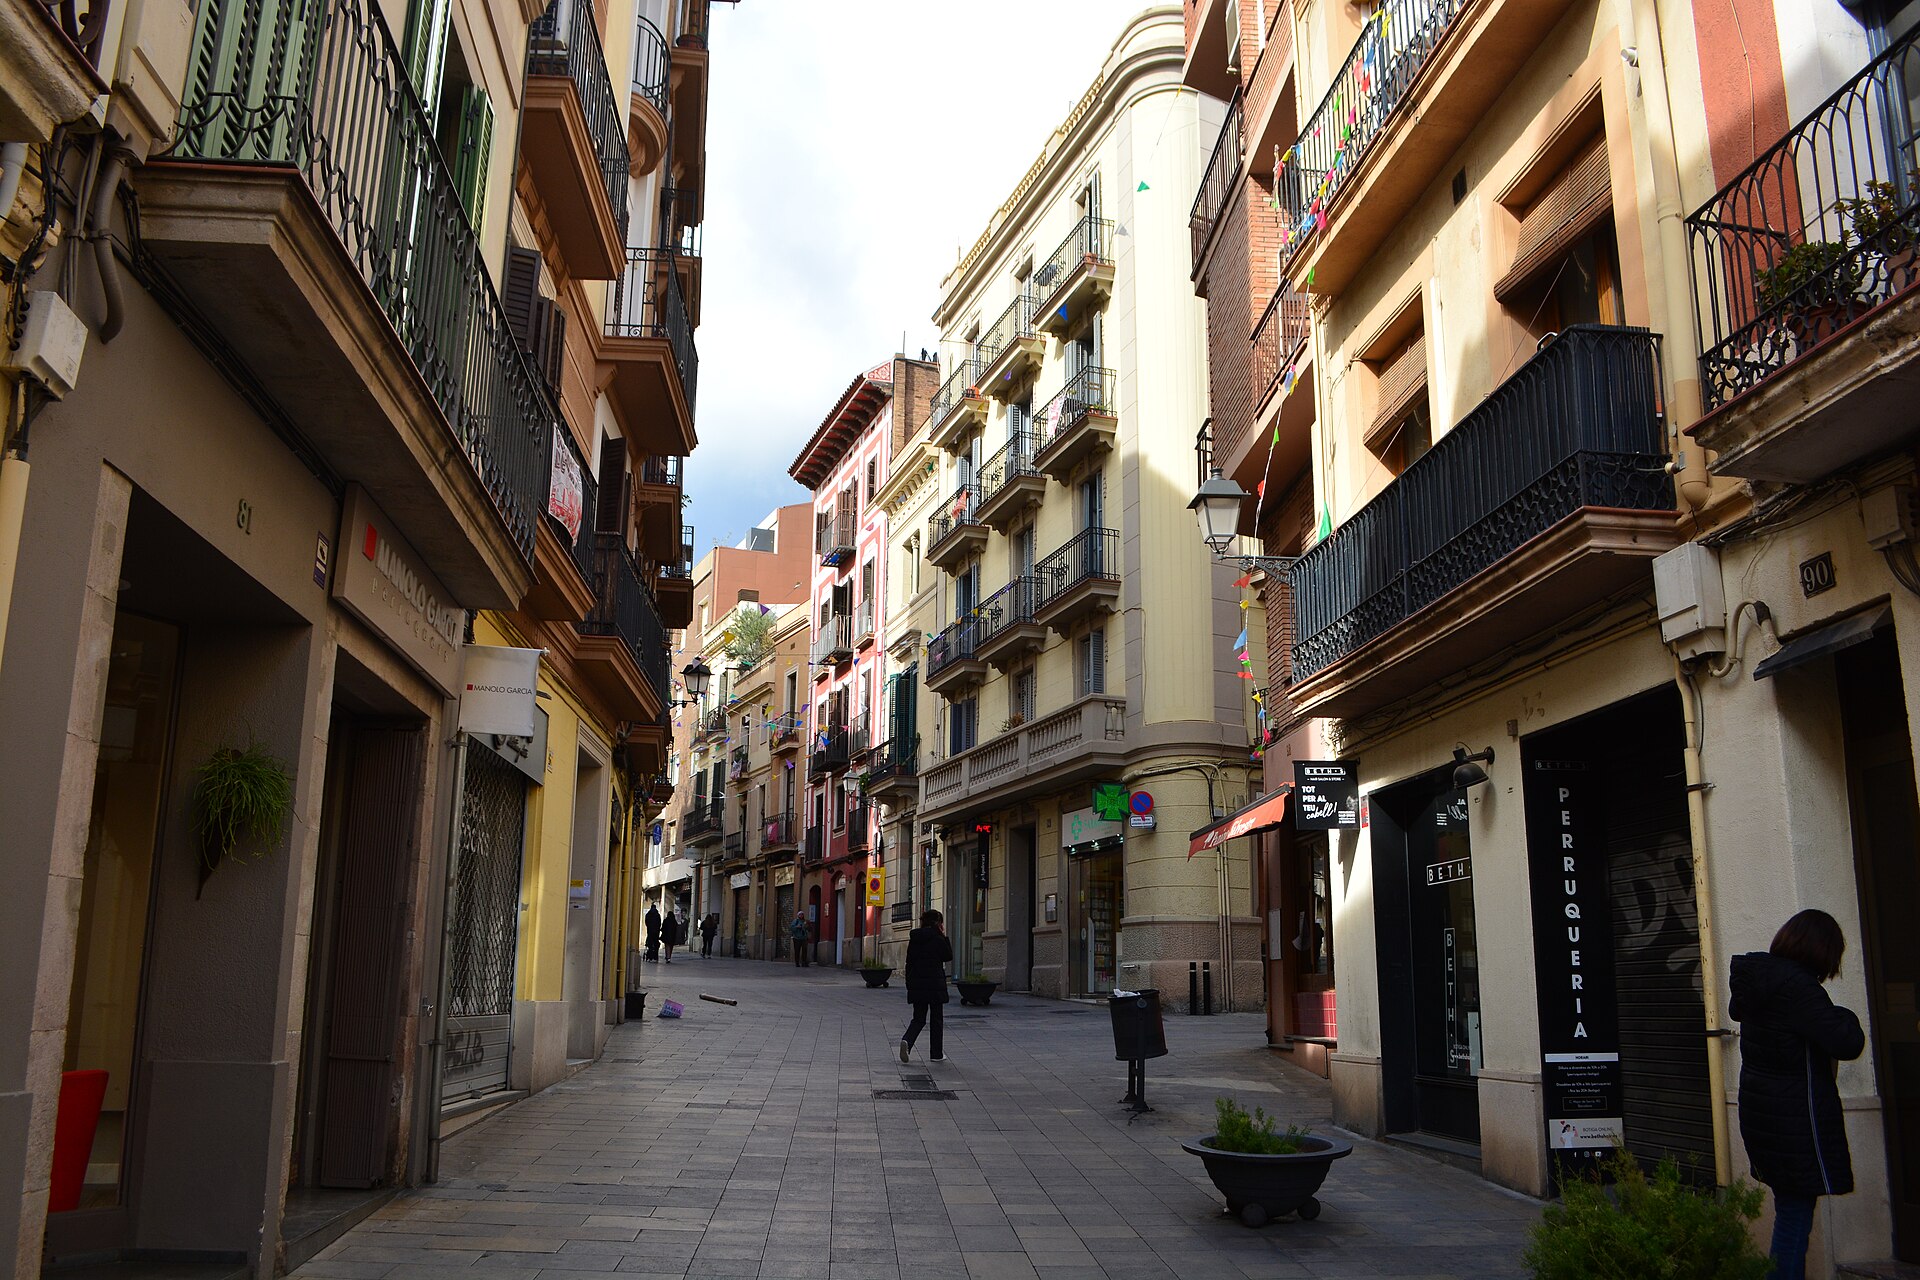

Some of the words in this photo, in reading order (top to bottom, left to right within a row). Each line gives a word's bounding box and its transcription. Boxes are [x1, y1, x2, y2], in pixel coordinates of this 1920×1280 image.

[237, 498, 252, 535] 81
[1803, 560, 1829, 592] 90
[376, 538, 426, 614] MANOLO
[426, 594, 458, 652] GARCIA
[474, 685, 506, 693] MANOLO
[507, 687, 532, 695] GARCIA
[1301, 785, 1316, 793] TOT
[1302, 804, 1316, 812] TEU
[1306, 801, 1338, 820] cabell!
[1558, 787, 1588, 1038] PERRUQUERIA
